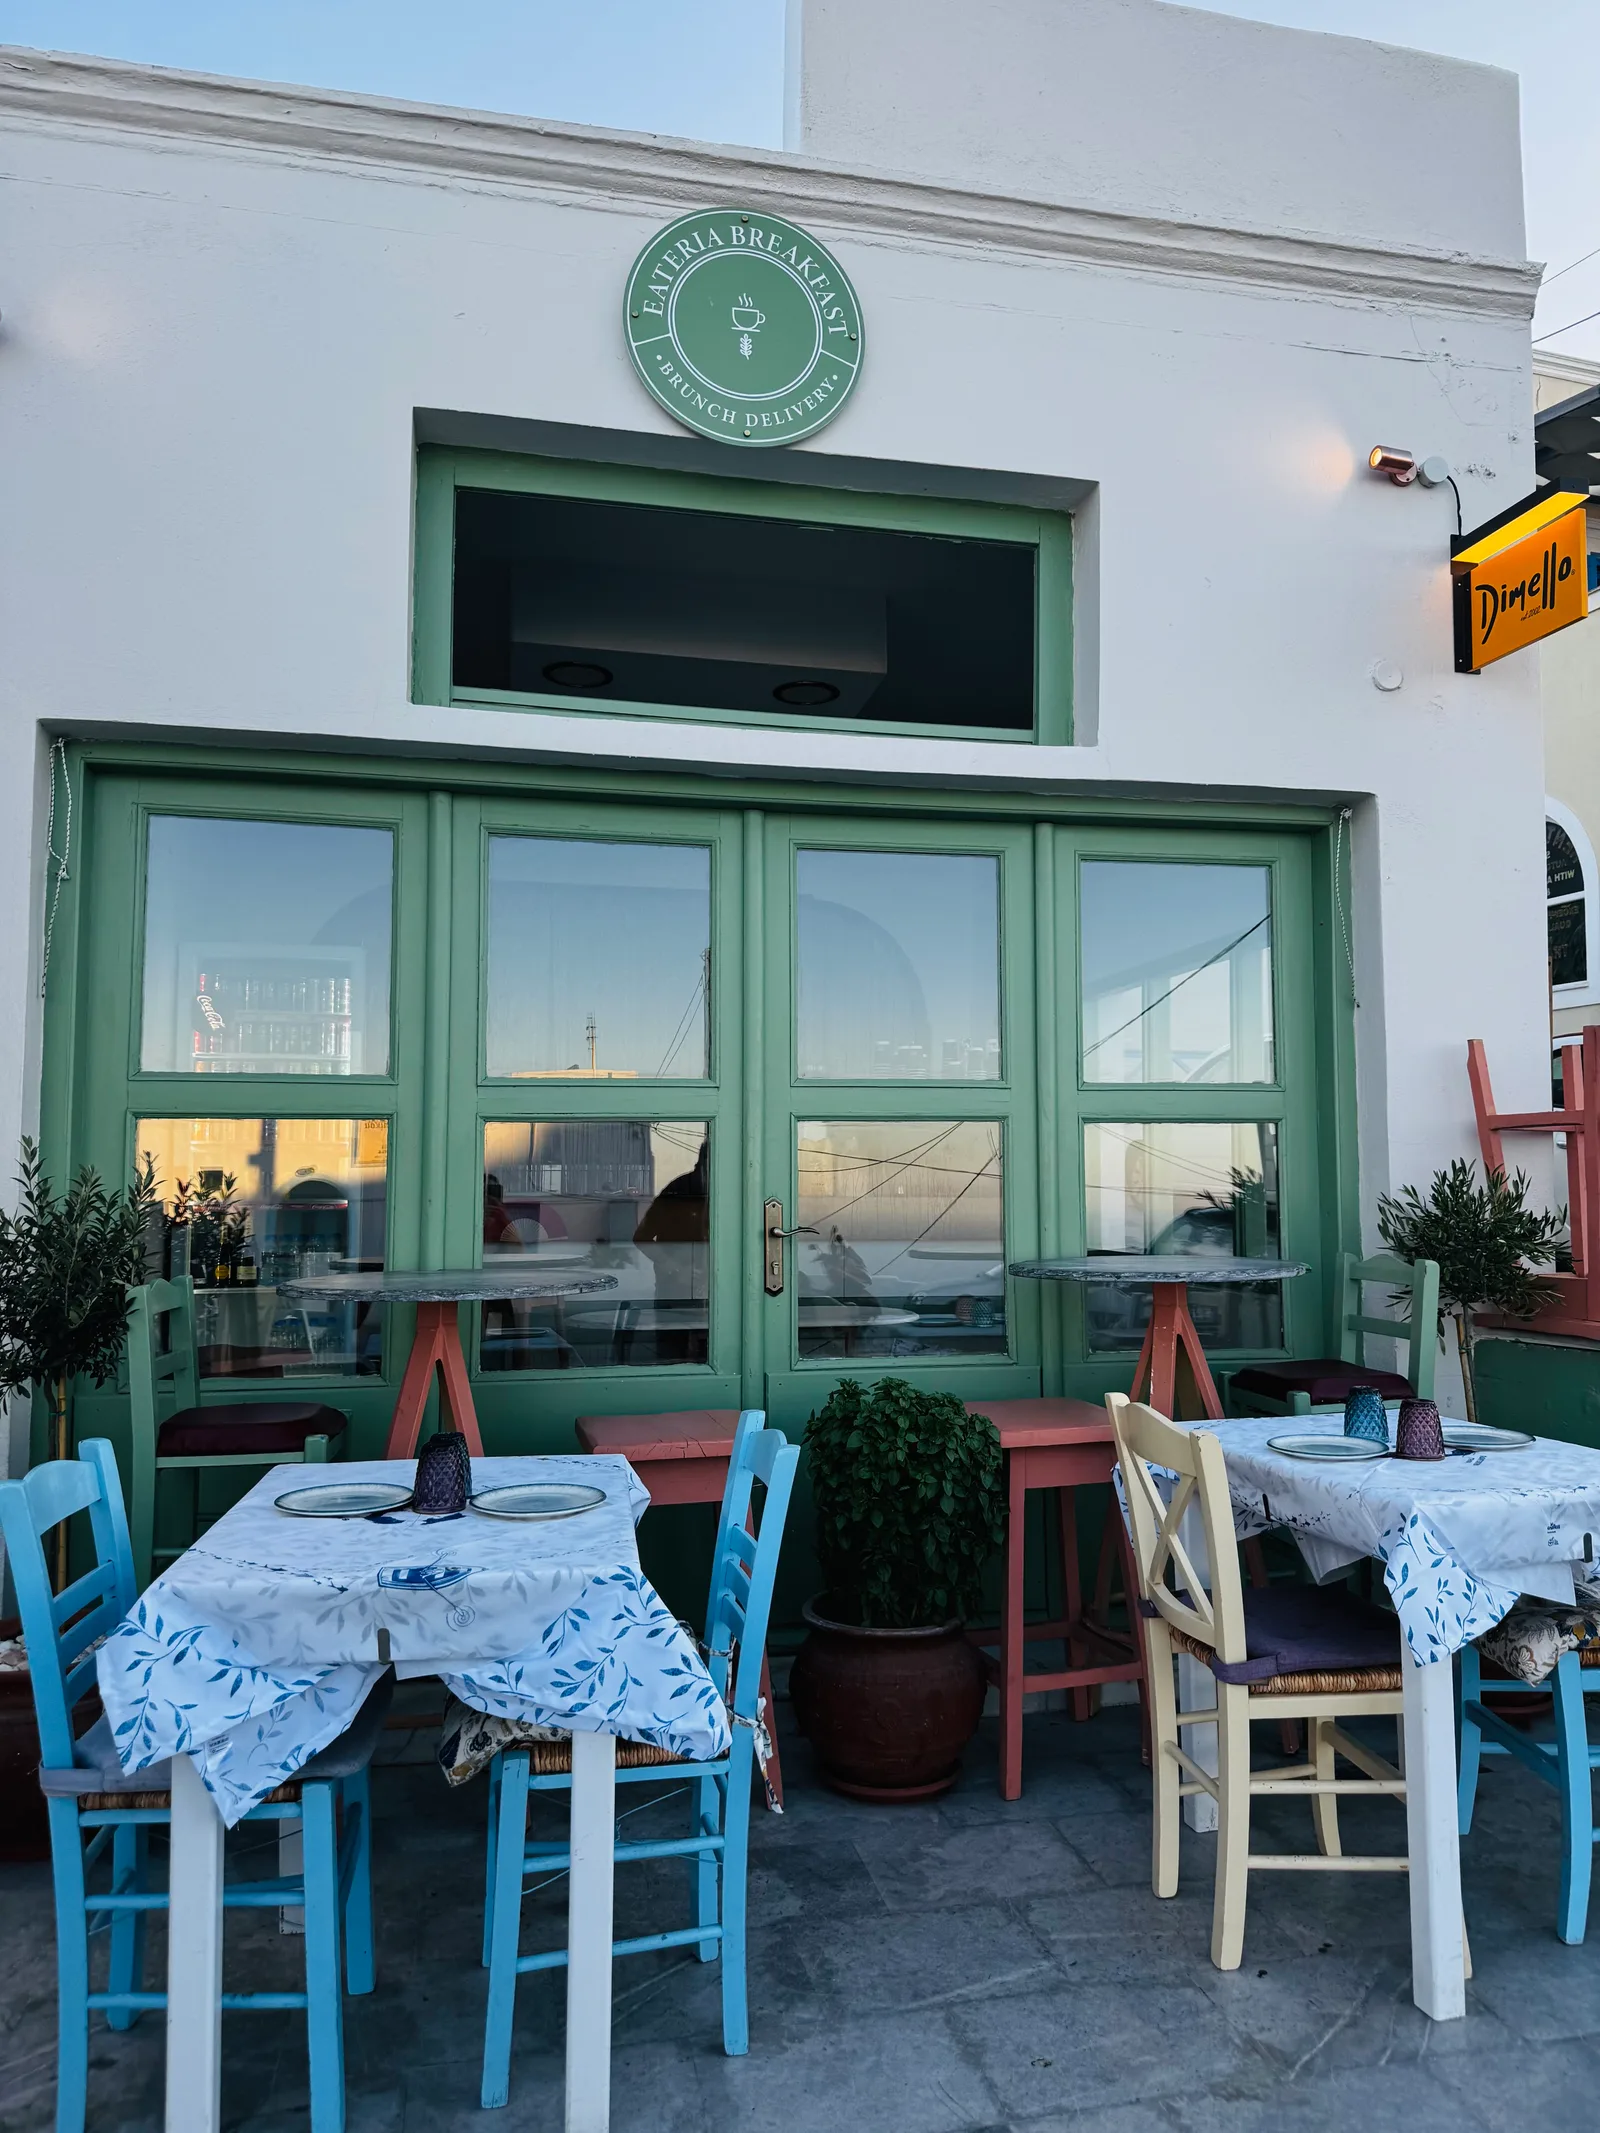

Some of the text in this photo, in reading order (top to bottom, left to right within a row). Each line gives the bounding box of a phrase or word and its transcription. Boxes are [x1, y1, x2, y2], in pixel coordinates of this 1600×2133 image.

[643, 225, 849, 337] EATERIA BREAKFAST
[660, 361, 834, 427] BRUNCH DELIVERY
[1475, 542, 1572, 645] Dimello
